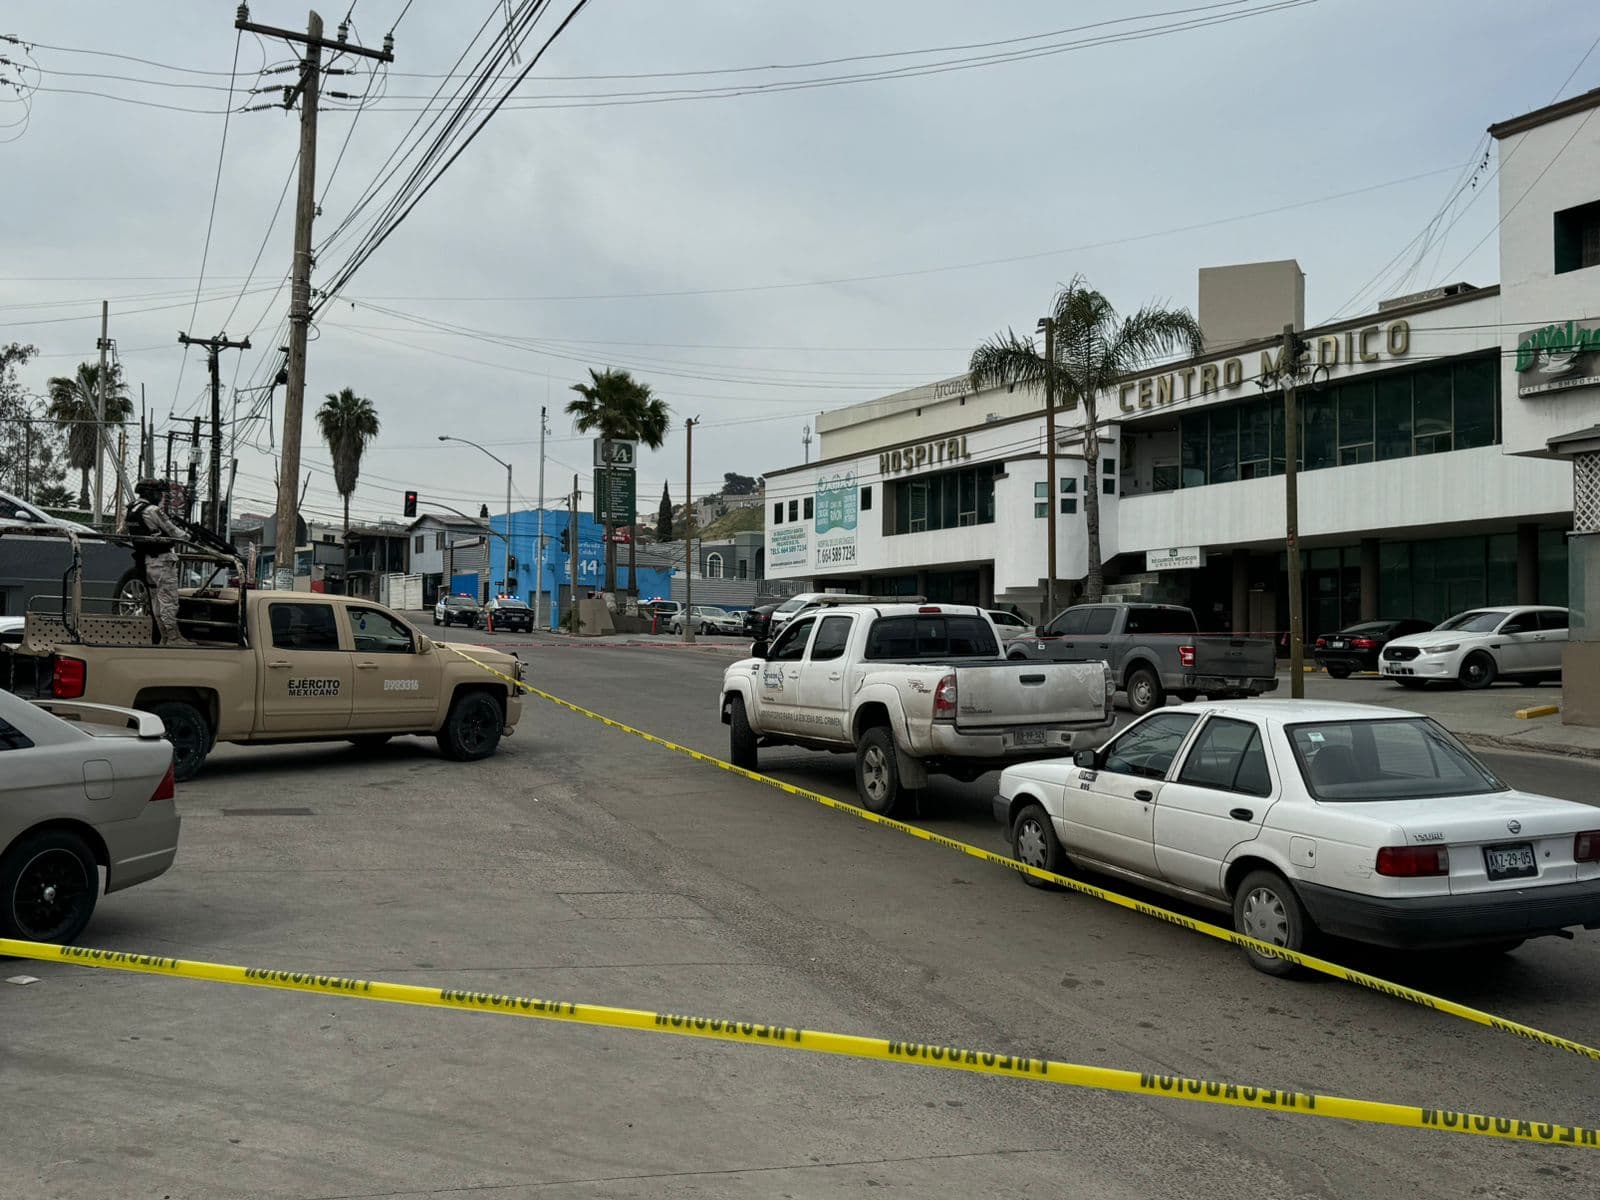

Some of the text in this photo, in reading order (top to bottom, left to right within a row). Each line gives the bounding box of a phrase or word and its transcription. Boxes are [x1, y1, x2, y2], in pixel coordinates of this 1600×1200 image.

[1119, 357, 1243, 412] CENTRO
[879, 435, 971, 475] HOSPITAL
[288, 677, 340, 689] EJÉRCITO
[288, 688, 339, 696] MEXICANO
